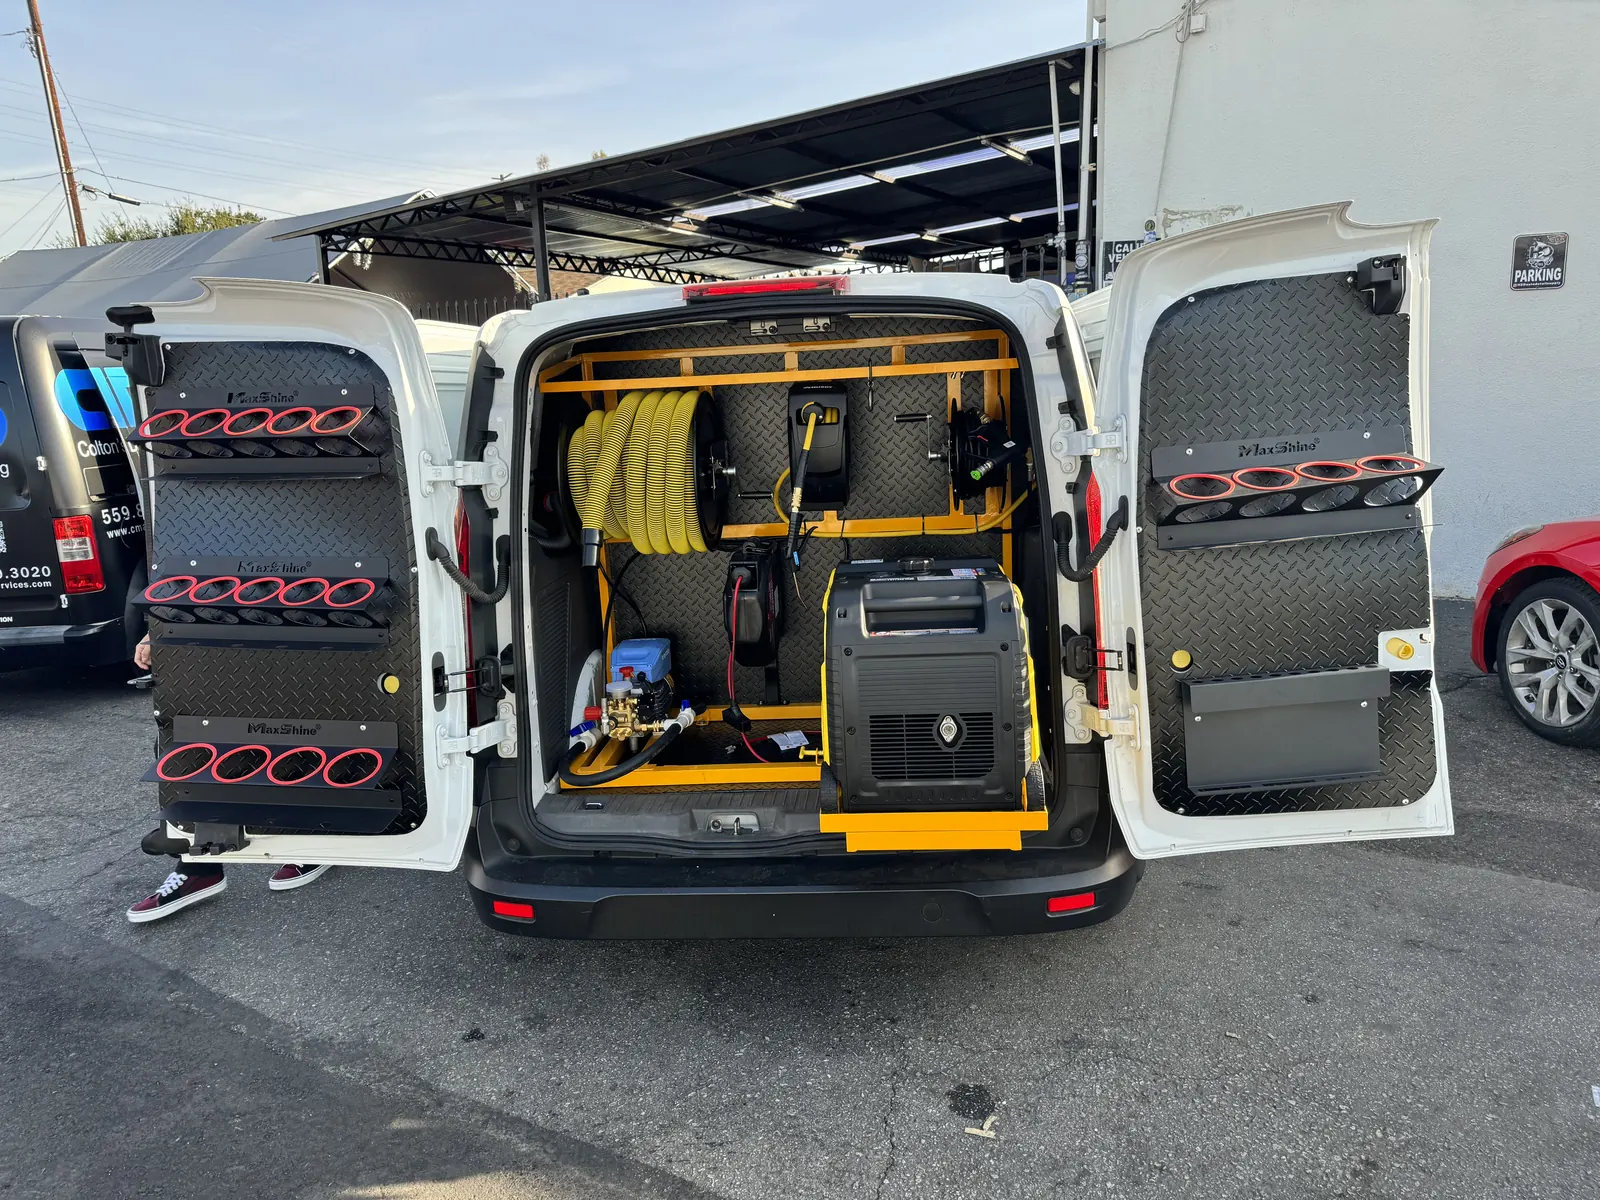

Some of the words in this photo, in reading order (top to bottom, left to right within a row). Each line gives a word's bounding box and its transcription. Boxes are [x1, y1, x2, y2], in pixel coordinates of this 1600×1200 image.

[1515, 268, 1561, 282] PARKING
[1238, 441, 1316, 458] MaxShine
[247, 722, 317, 736] MaxShine
